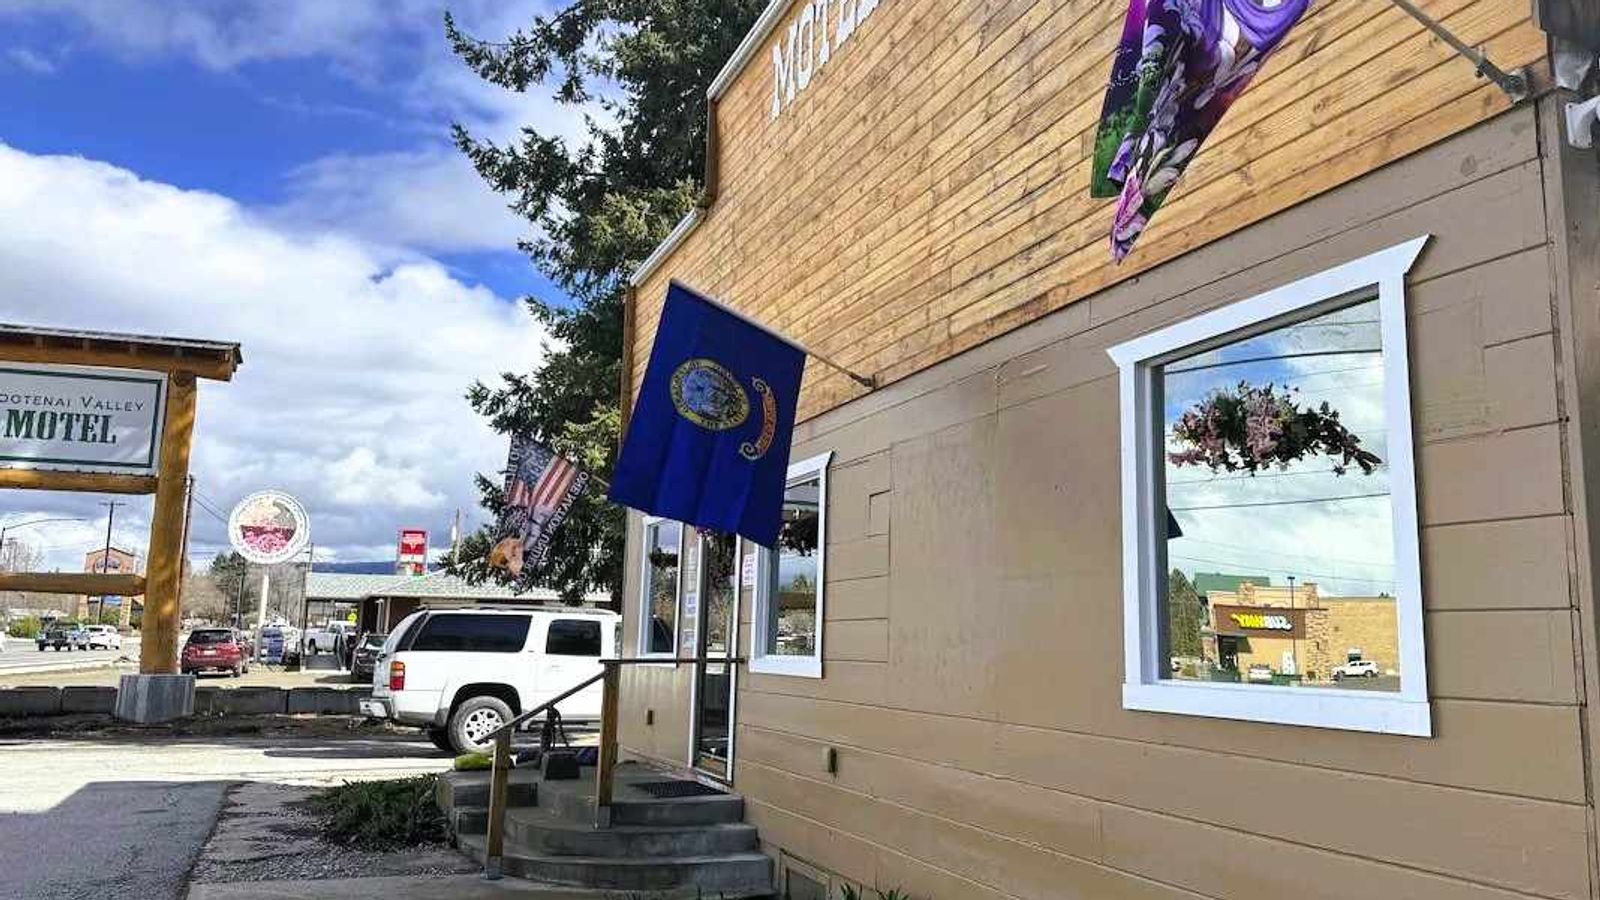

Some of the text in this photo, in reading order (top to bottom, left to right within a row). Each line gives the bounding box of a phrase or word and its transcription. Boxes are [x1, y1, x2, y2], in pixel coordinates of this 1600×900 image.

[0, 393, 145, 412] OOTENAI VALLEY
[4, 408, 117, 444] MOTEL
